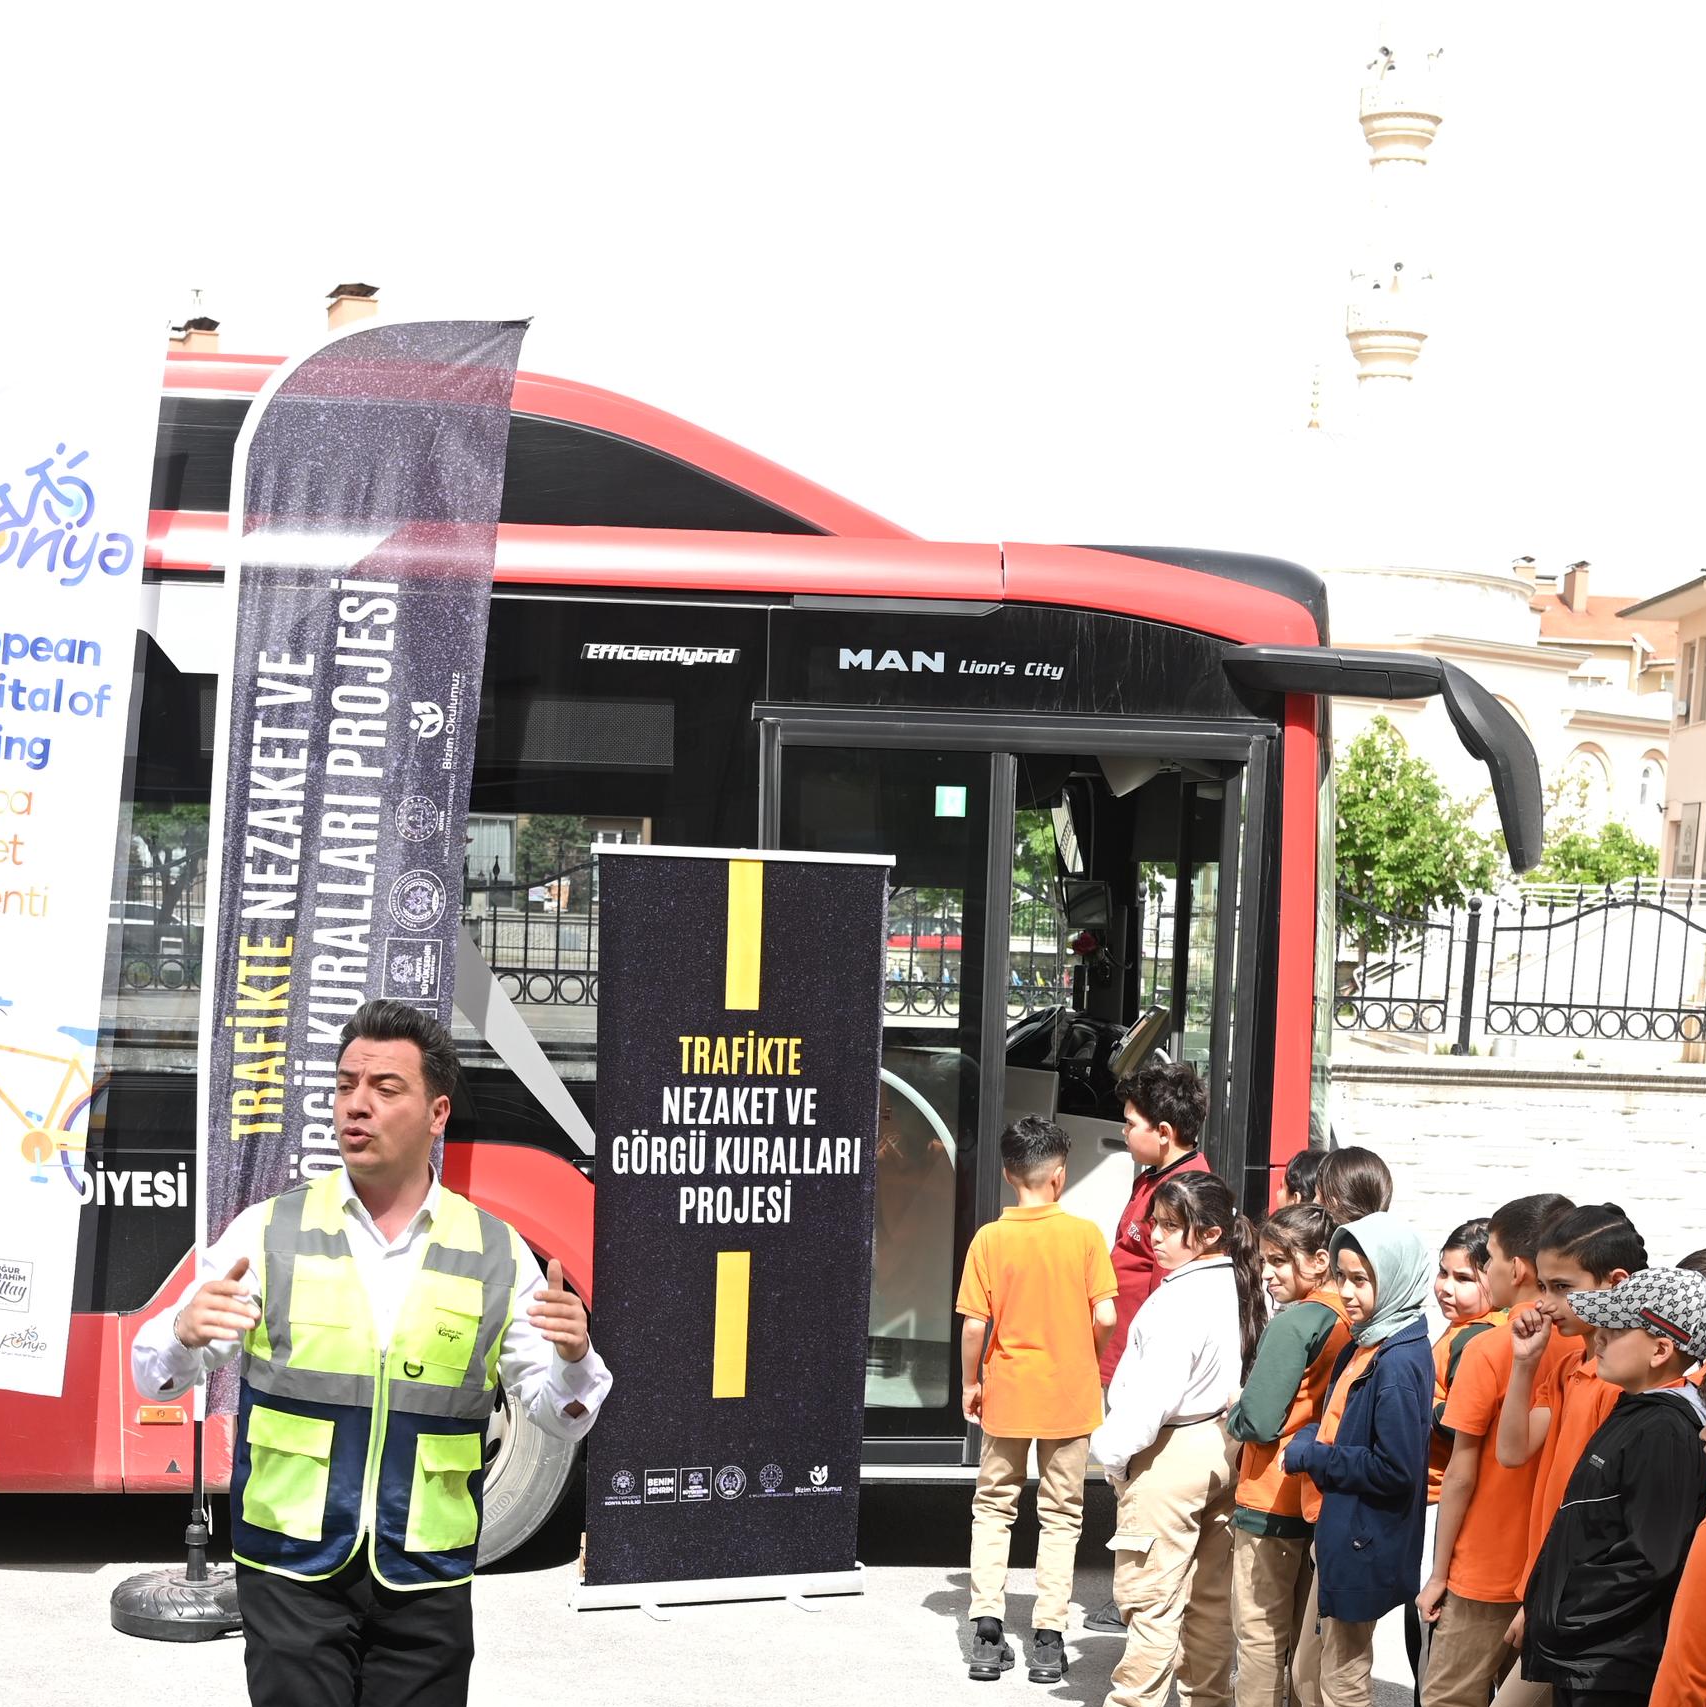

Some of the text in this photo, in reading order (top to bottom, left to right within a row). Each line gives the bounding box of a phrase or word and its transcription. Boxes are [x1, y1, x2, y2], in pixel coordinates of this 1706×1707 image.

[586, 644, 736, 666] EfficientHybrid
[839, 648, 1065, 681] MAN Lion's City
[68, 684, 112, 718] of
[445, 672, 461, 735] Okulumuz
[442, 737, 454, 770] Bizim
[225, 651, 315, 1142] TRAFİKTE NEZAKET VE
[289, 579, 399, 1180] ÖRGÜ KURALLARI PROJESİ
[679, 1030, 802, 1076] TRAFİKTE
[662, 1086, 817, 1125] NEZAKET VE
[612, 1129, 861, 1175] GÖRGÜ KURALLARI
[79, 1160, 189, 1207] DİYESİ
[679, 1179, 792, 1224] PROJESİ
[794, 1486, 812, 1494] Bizim
